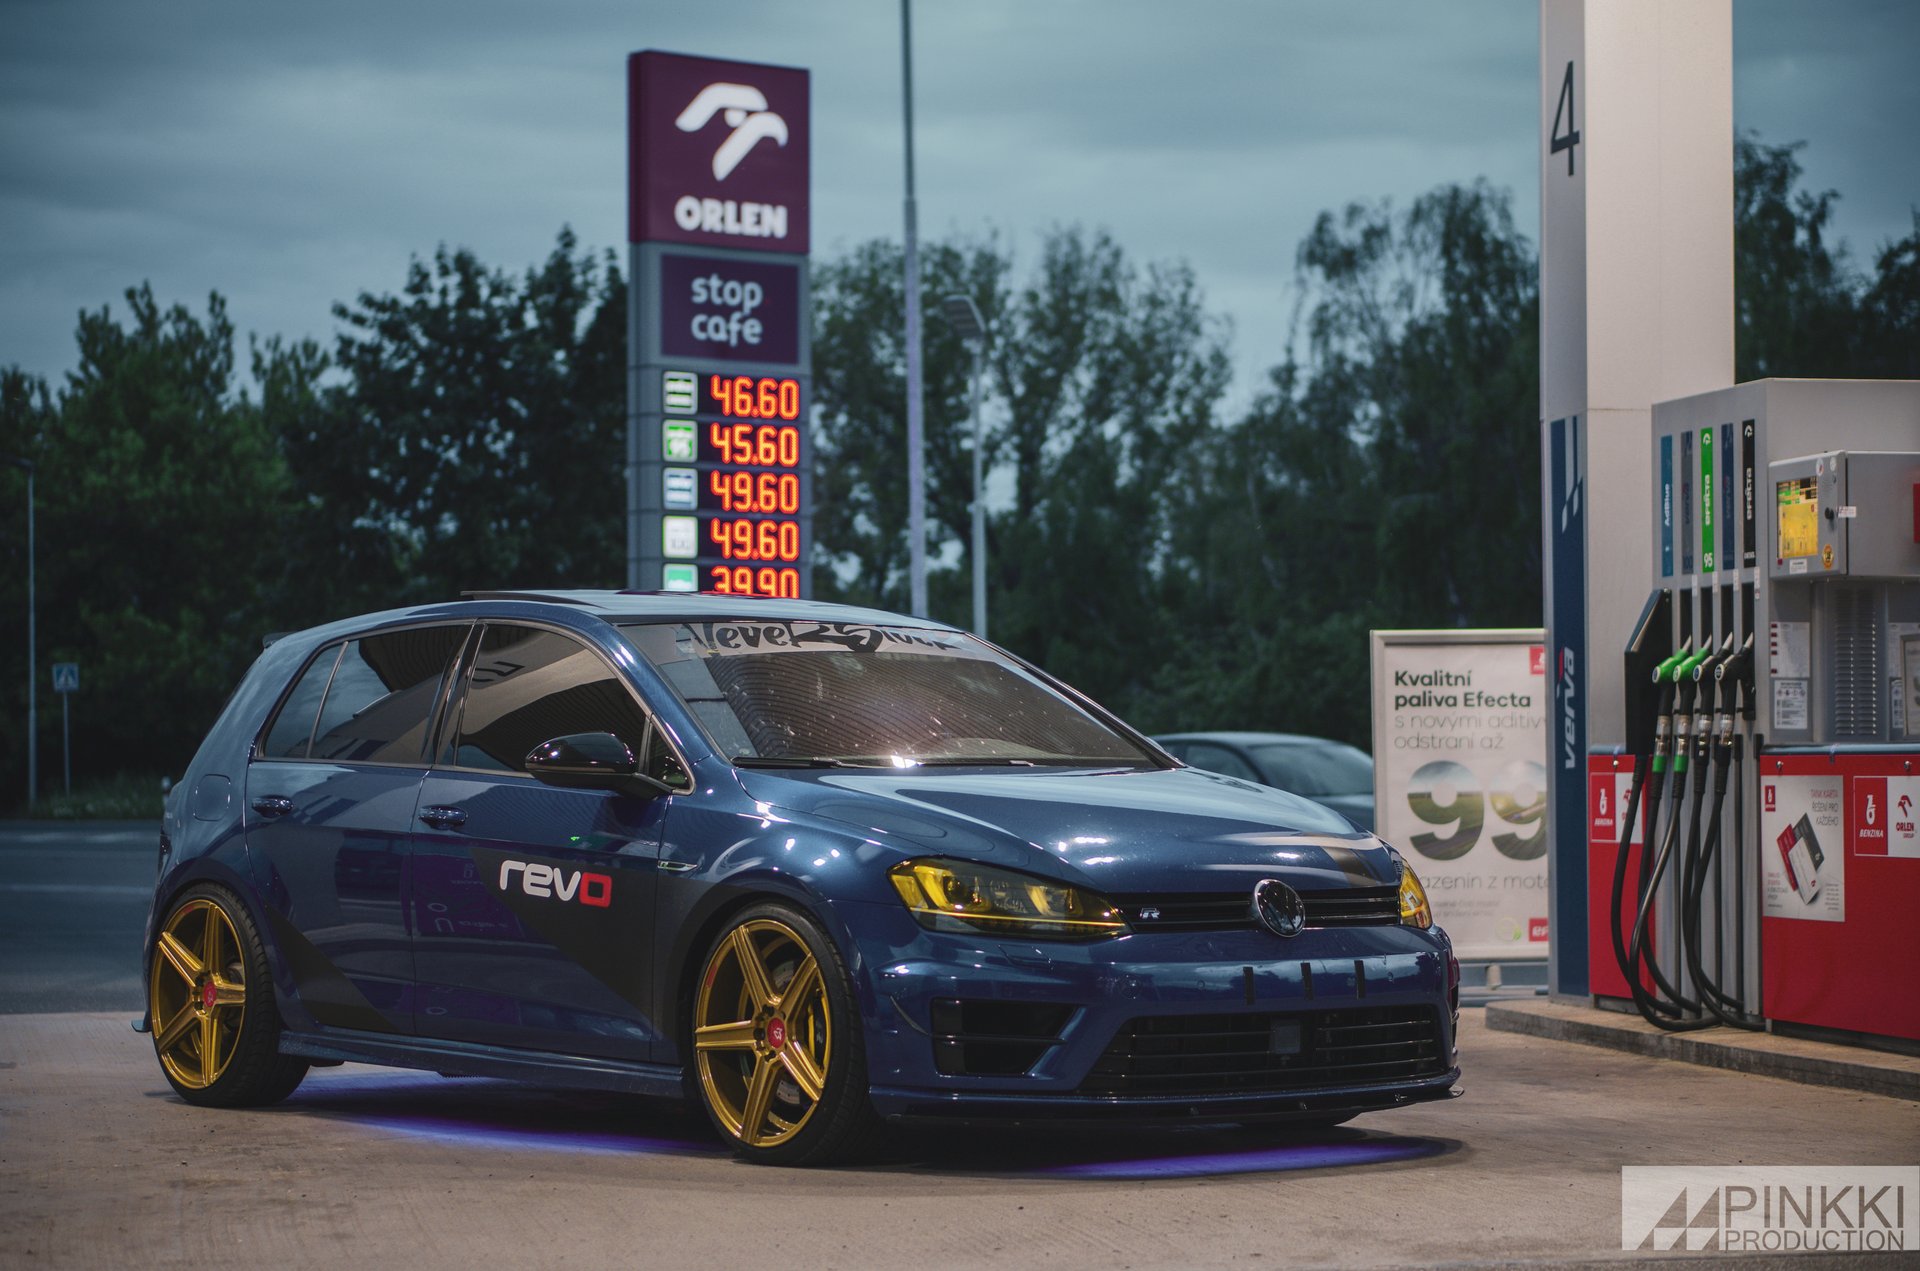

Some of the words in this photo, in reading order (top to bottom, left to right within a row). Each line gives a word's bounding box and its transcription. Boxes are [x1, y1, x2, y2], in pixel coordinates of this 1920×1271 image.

[1550, 60, 1580, 177] 4
[674, 195, 788, 239] ORLEN
[691, 273, 763, 315] stop
[691, 312, 763, 347] cafe
[710, 374, 799, 420] 46.60
[710, 422, 799, 467] 45.60
[710, 470, 799, 514] 49.60
[710, 517, 799, 562] 49.60
[1703, 552, 1713, 569] 95
[711, 565, 799, 599] 3990
[1394, 670, 1472, 687] Kvalitní
[1394, 690, 1458, 711] paliva
[1463, 691, 1532, 708] Efecta
[1410, 711, 1482, 731] novými
[1563, 646, 1576, 769] verva
[1896, 822, 1914, 831] ORLEN
[500, 859, 612, 908] revo
[1420, 871, 1482, 889] azenin
